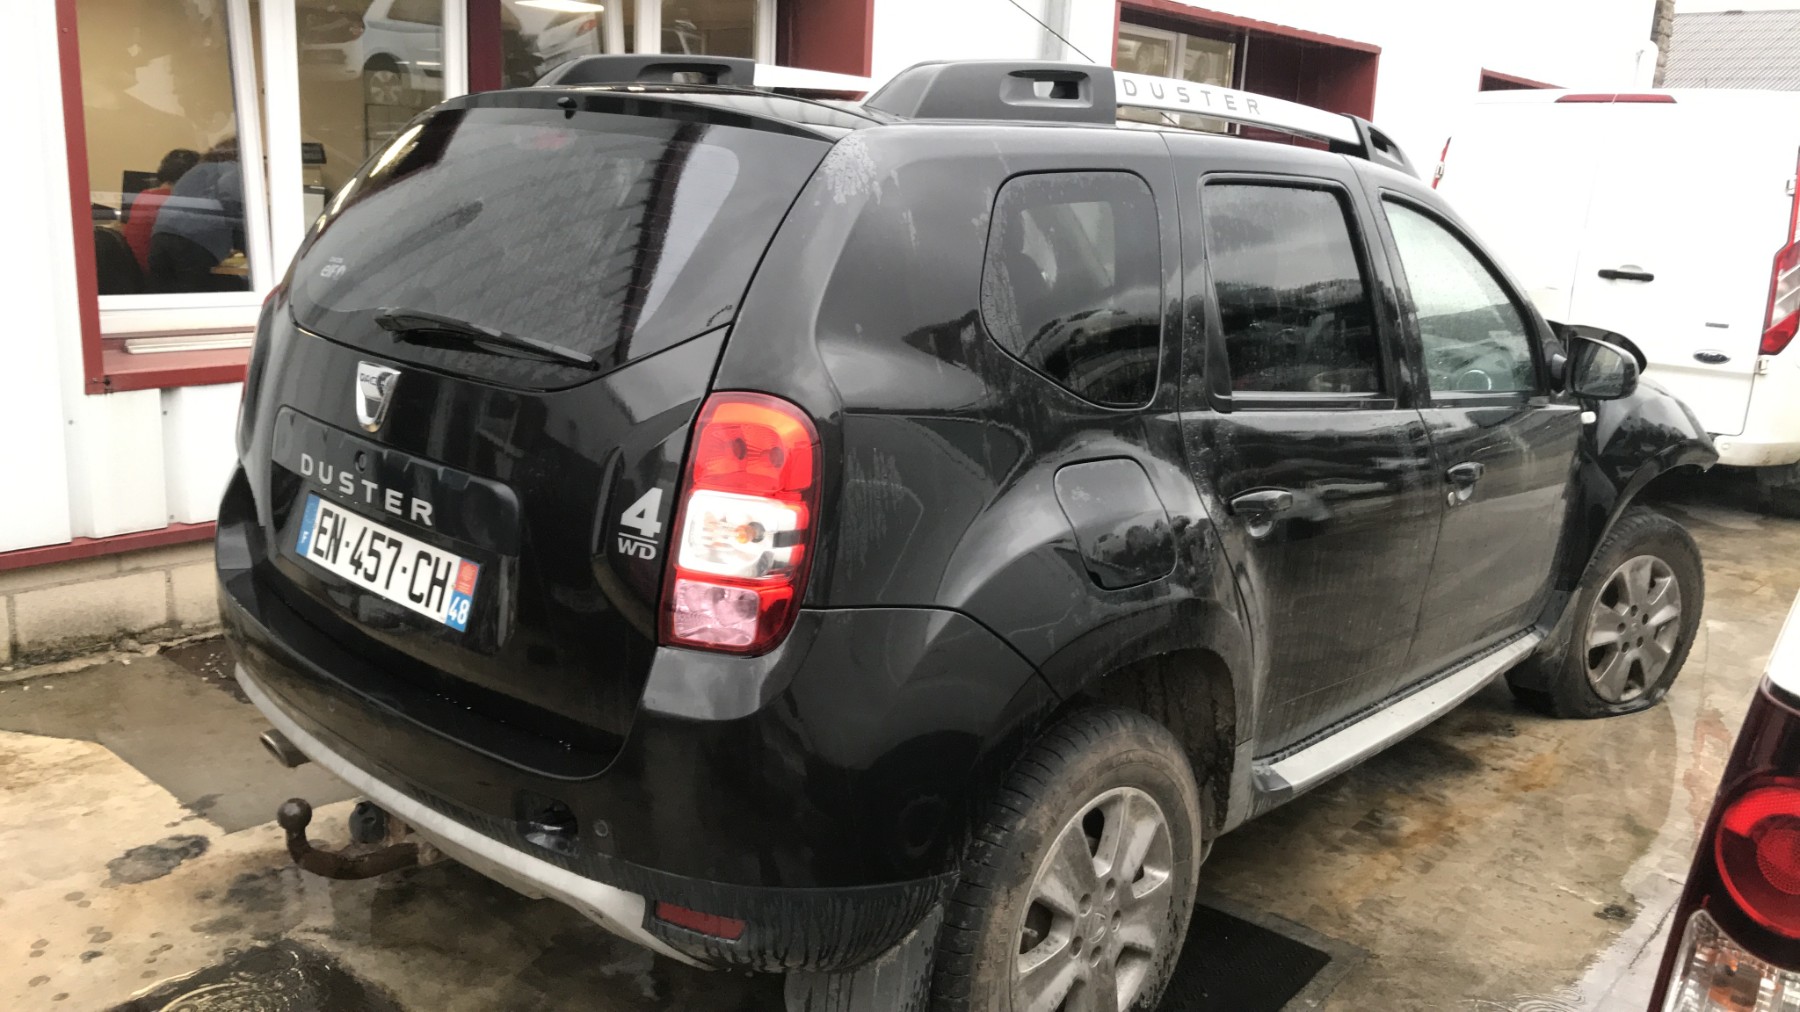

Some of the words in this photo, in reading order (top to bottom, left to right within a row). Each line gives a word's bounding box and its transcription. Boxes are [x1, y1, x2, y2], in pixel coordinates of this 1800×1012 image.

[1122, 79, 1260, 115] DUSTER
[300, 453, 433, 526] DUSTER
[620, 487, 663, 538] 4
[618, 537, 657, 560] WD
[449, 596, 470, 625] 48
